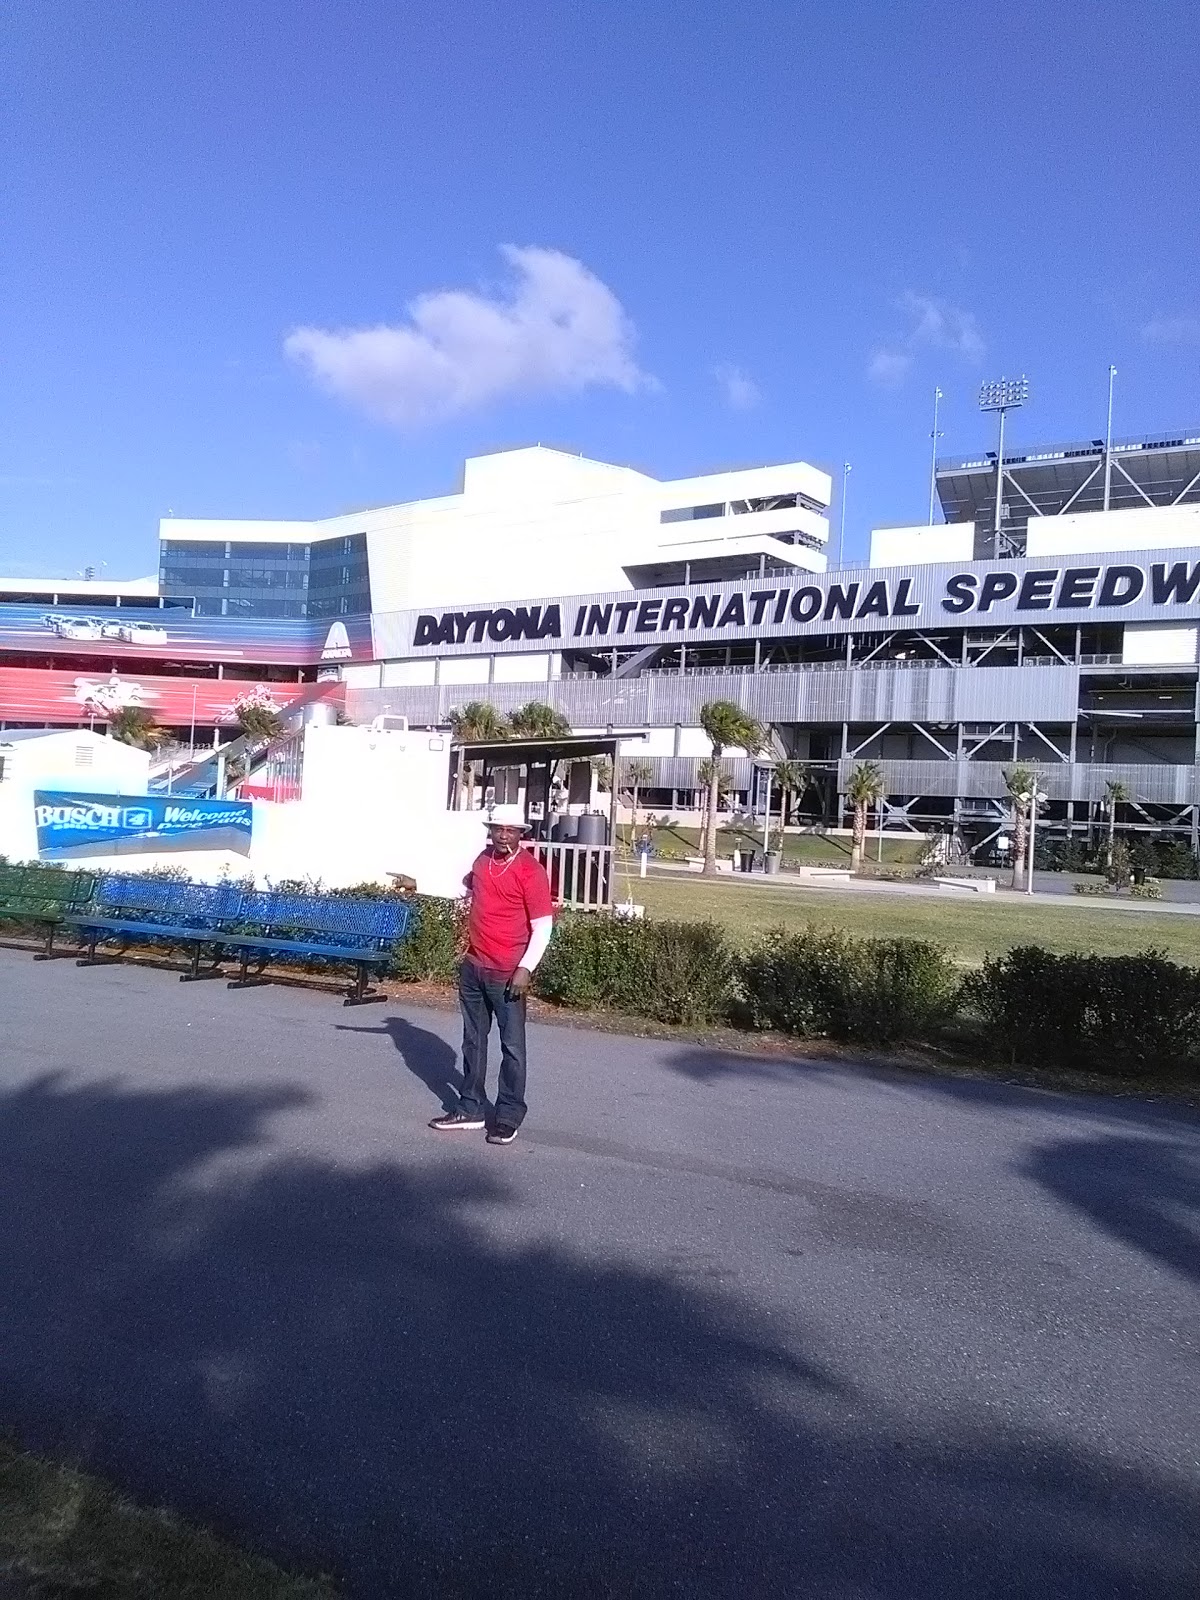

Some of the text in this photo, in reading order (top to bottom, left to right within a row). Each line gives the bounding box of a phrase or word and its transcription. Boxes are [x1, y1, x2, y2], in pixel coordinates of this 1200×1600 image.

[413, 604, 562, 647] DAYTONA
[573, 577, 921, 637] INTERNATIONAL
[35, 805, 120, 828] BUSCH
[164, 806, 247, 822] Welcome
